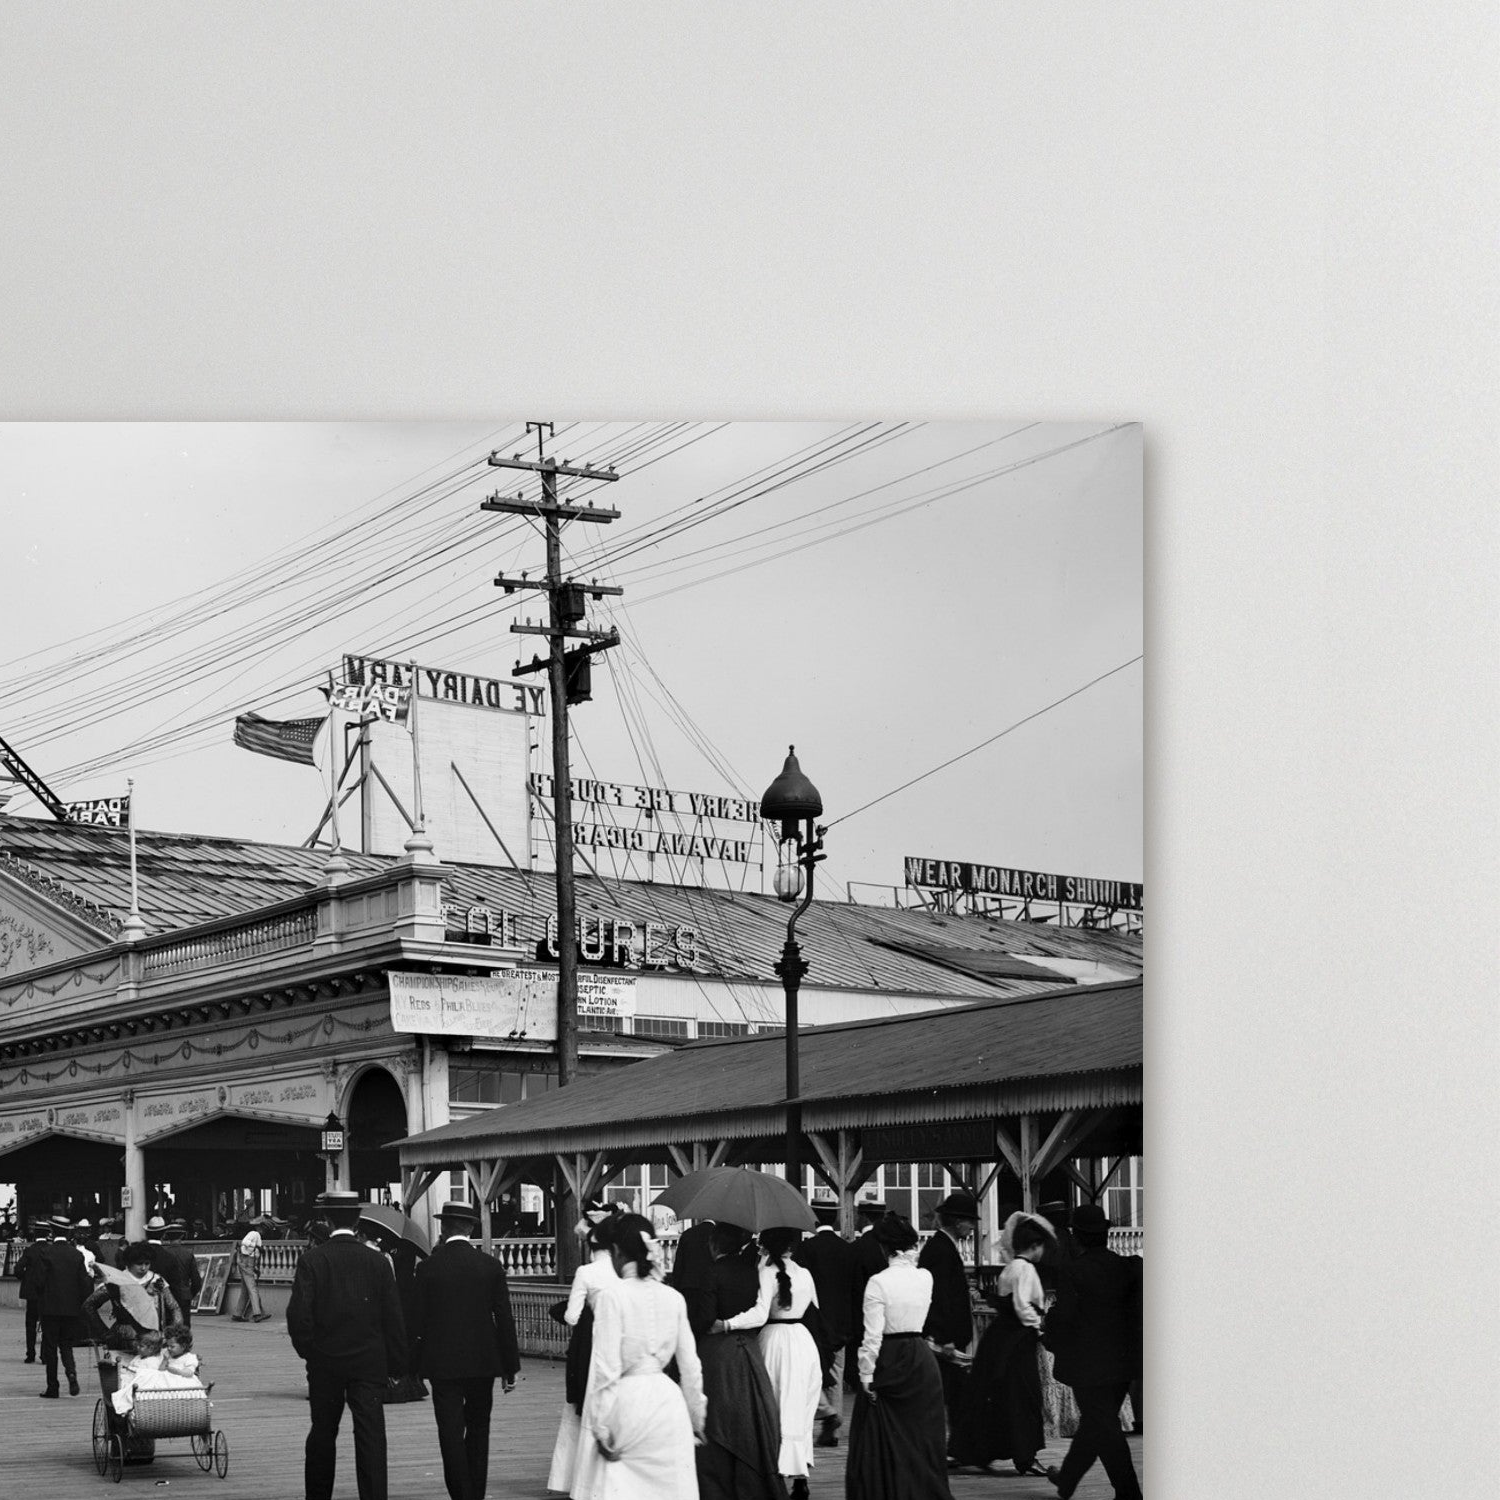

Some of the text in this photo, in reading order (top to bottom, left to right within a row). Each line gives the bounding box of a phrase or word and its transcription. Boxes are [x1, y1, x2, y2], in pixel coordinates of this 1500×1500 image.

[908, 857, 963, 888] WEAR
[971, 865, 1058, 899] MONARCH
[577, 984, 606, 995] SEPTIC
[588, 994, 618, 1006] LOTION
[577, 1005, 606, 1015] TLANTIC
